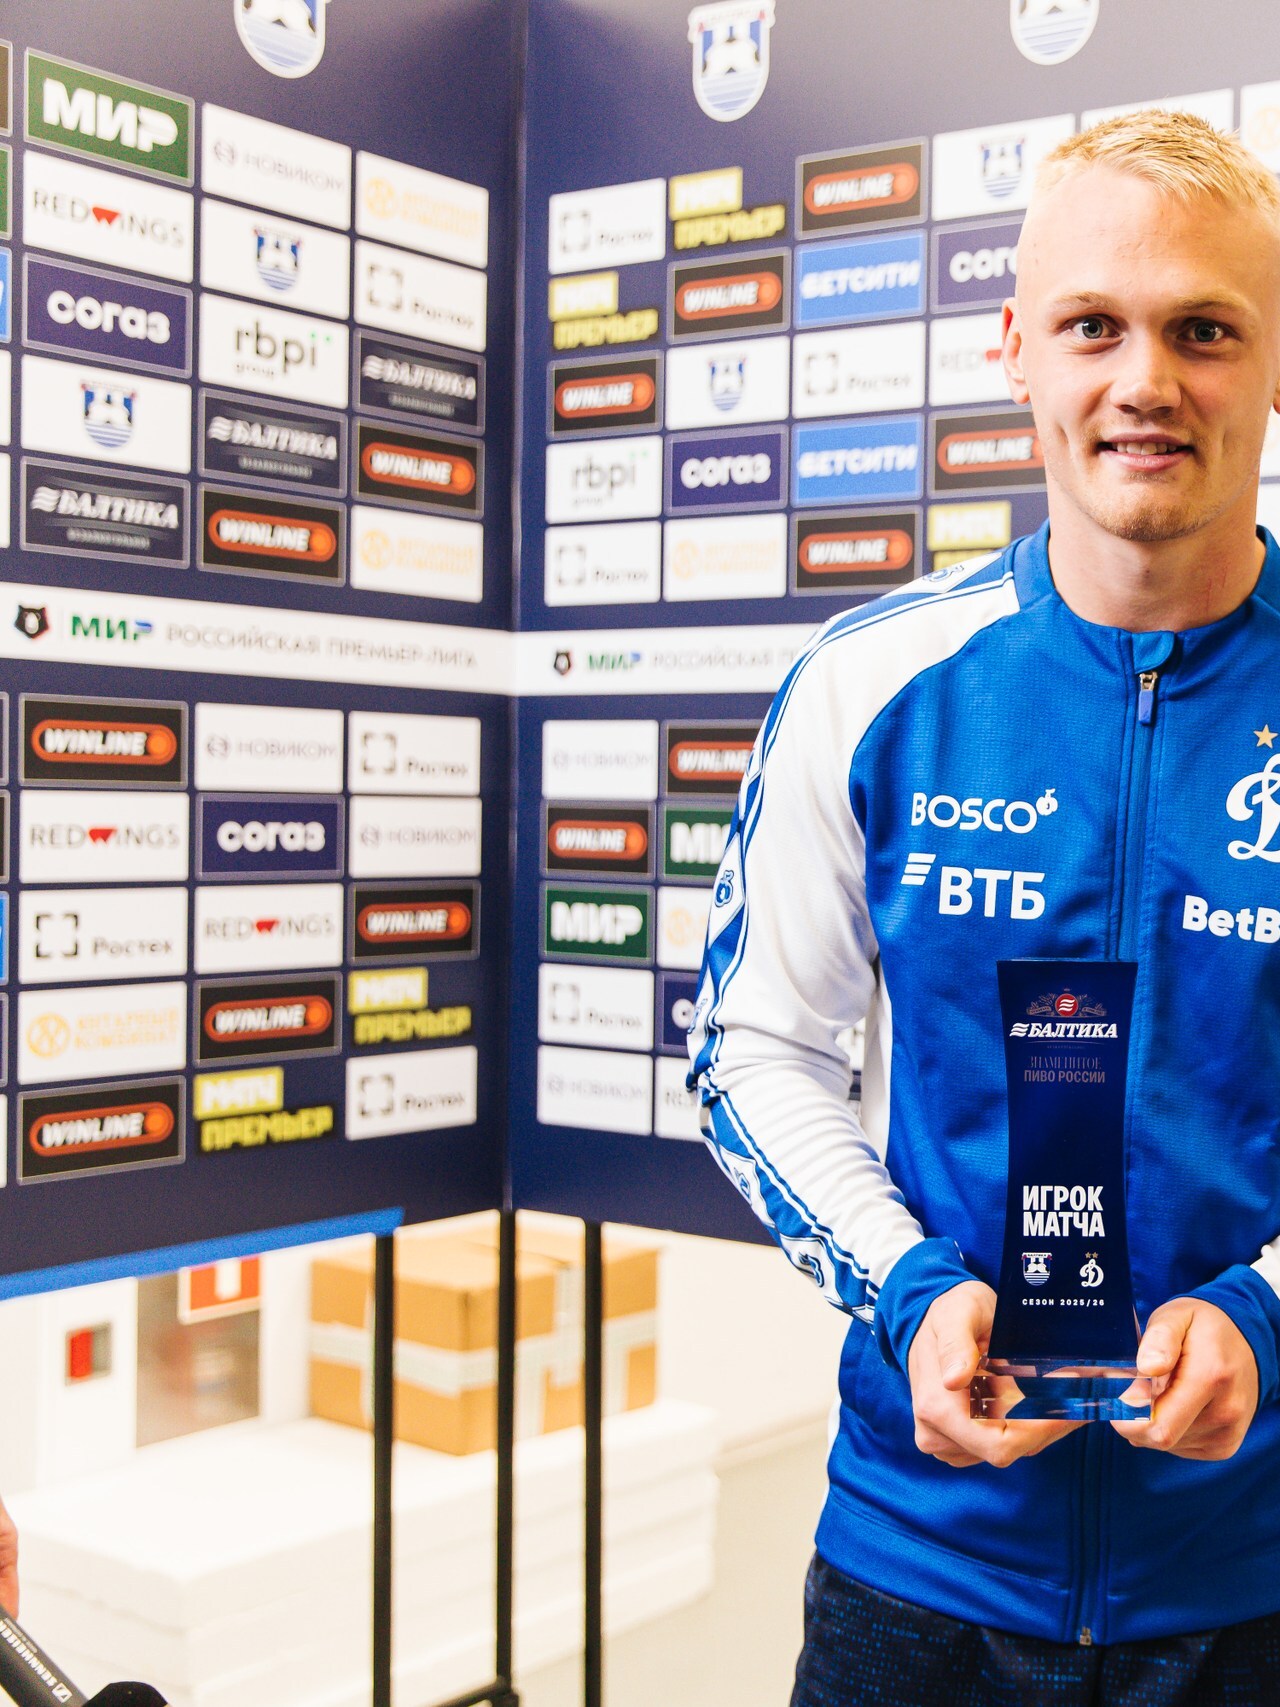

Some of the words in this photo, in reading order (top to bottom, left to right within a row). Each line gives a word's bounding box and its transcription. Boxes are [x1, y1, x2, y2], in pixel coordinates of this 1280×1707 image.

[42, 77, 178, 152] МИР
[812, 173, 893, 208] WINLINE
[683, 281, 759, 311] WINLINE
[385, 359, 476, 399] БАЛТИКА
[563, 380, 633, 409] WINLINE
[233, 420, 336, 460] БАЛТИКА
[946, 435, 1032, 466] WINLINE
[370, 449, 452, 484] WINLINE
[57, 489, 178, 528] БАЛТИКА
[219, 519, 309, 552] WINLINE
[807, 537, 888, 566] WINLINE
[71, 614, 153, 642] МИР
[44, 728, 146, 757] WINLINE
[910, 792, 1038, 834] BOSCO
[554, 827, 627, 852] WINLINE
[938, 866, 1046, 920] ВТБ
[368, 910, 447, 934] WINLINE
[551, 901, 642, 943] МИР
[92, 936, 173, 958] Ростех
[215, 1005, 305, 1033] WINLINE
[355, 1006, 471, 1044] ПРЕМЬЕР
[1028, 1023, 1118, 1038] БАЛТИКА
[1024, 1070, 1056, 1082] ПИВО
[1058, 1071, 1105, 1083] РОССИИ
[1029, 1056, 1101, 1069] ЗНАМЕНИТОЕ
[42, 1112, 143, 1146] WINLINE
[201, 1106, 333, 1152] ПРЕМЬЕР
[1023, 1185, 1104, 1211] ИГРОК
[1023, 1211, 1105, 1237] МАТЧА
[1060, 1299, 1105, 1307] 2025/26
